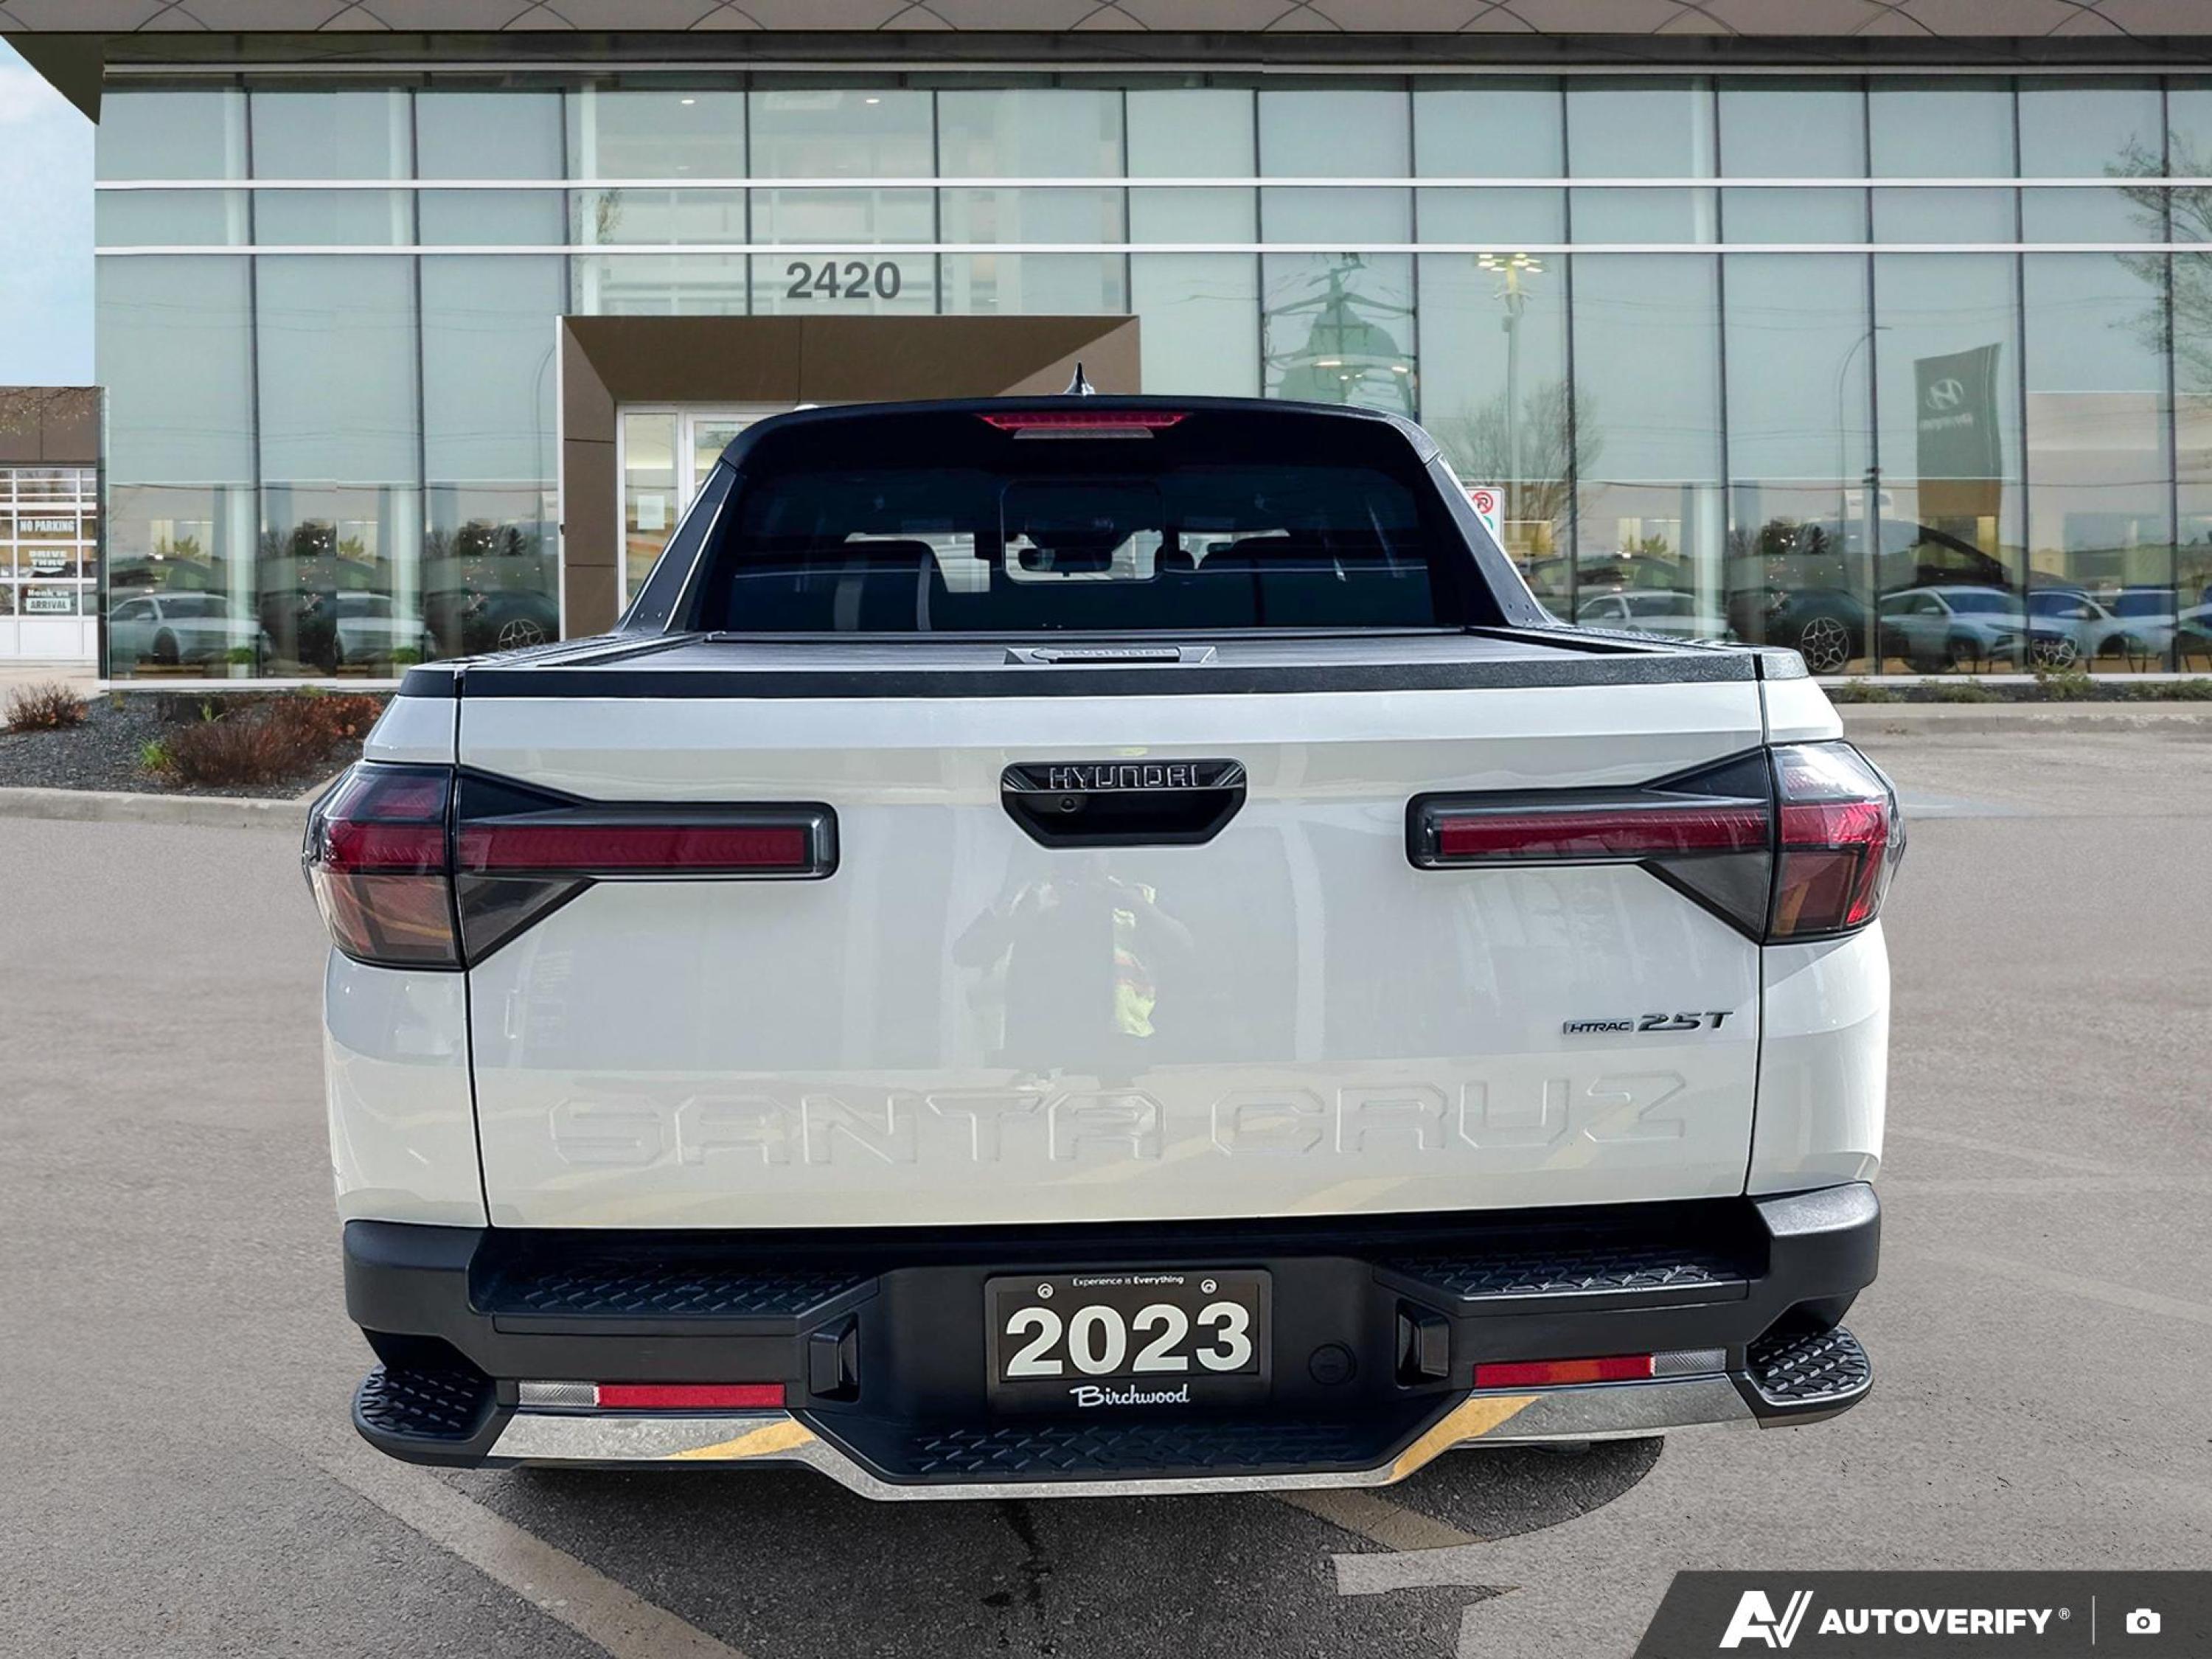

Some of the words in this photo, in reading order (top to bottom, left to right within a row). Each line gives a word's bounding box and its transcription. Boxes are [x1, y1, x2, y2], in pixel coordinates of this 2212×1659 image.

[785, 260, 902, 300] 2420
[30, 599, 67, 609] ARRIVAL
[1048, 764, 1200, 790] HYUNDAI
[1570, 1021, 1632, 1033] HTRAC
[548, 1086, 1167, 1166] SANTA
[1211, 1069, 1686, 1157] CRUZ
[1073, 1277, 1123, 1287] Experience
[1133, 1275, 1184, 1285] Everything
[1005, 1301, 1253, 1377] 2023
[1068, 1382, 1191, 1408] Birchwood
